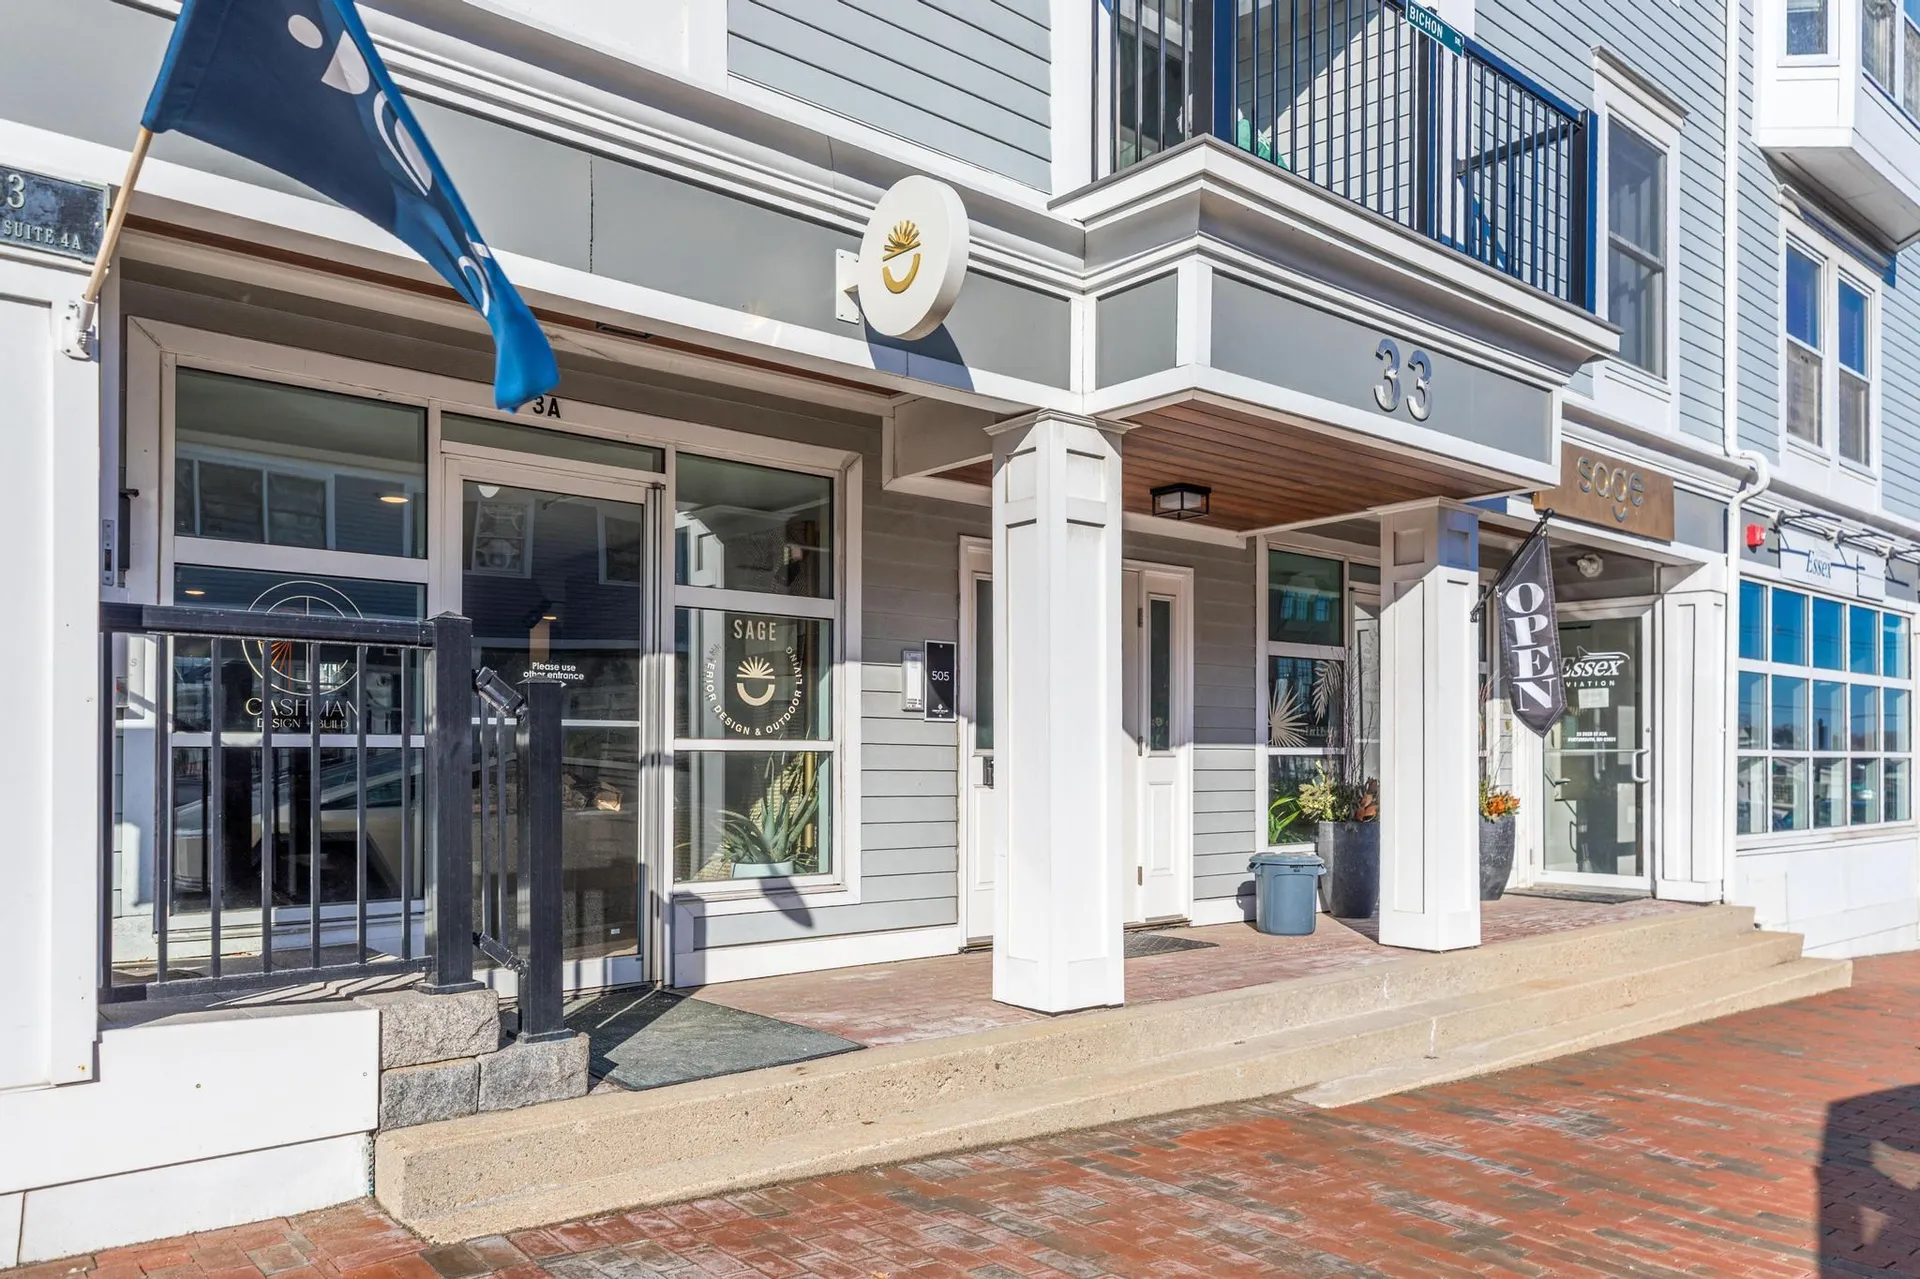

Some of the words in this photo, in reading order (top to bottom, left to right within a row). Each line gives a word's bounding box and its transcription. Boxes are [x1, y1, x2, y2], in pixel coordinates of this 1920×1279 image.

[1409, 5, 1443, 38] BICHON
[3, 219, 55, 245] SUITE
[60, 232, 81, 251] 4A
[1373, 338, 1433, 422] 33
[1577, 456, 1645, 523] sage
[733, 619, 777, 641] SAGE
[1505, 582, 1555, 712] OPEN
[532, 661, 560, 671] Please
[561, 664, 577, 672] use
[547, 671, 585, 680] entrance
[931, 670, 950, 682] 505
[1561, 657, 1625, 678] Essex
[713, 704, 750, 735] DESIGN
[754, 727, 762, 736] &
[765, 689, 802, 735] OUTDOOR
[785, 646, 803, 685] LIVING
[1565, 680, 1616, 688] VIATION
[257, 718, 301, 729] DSIGN
